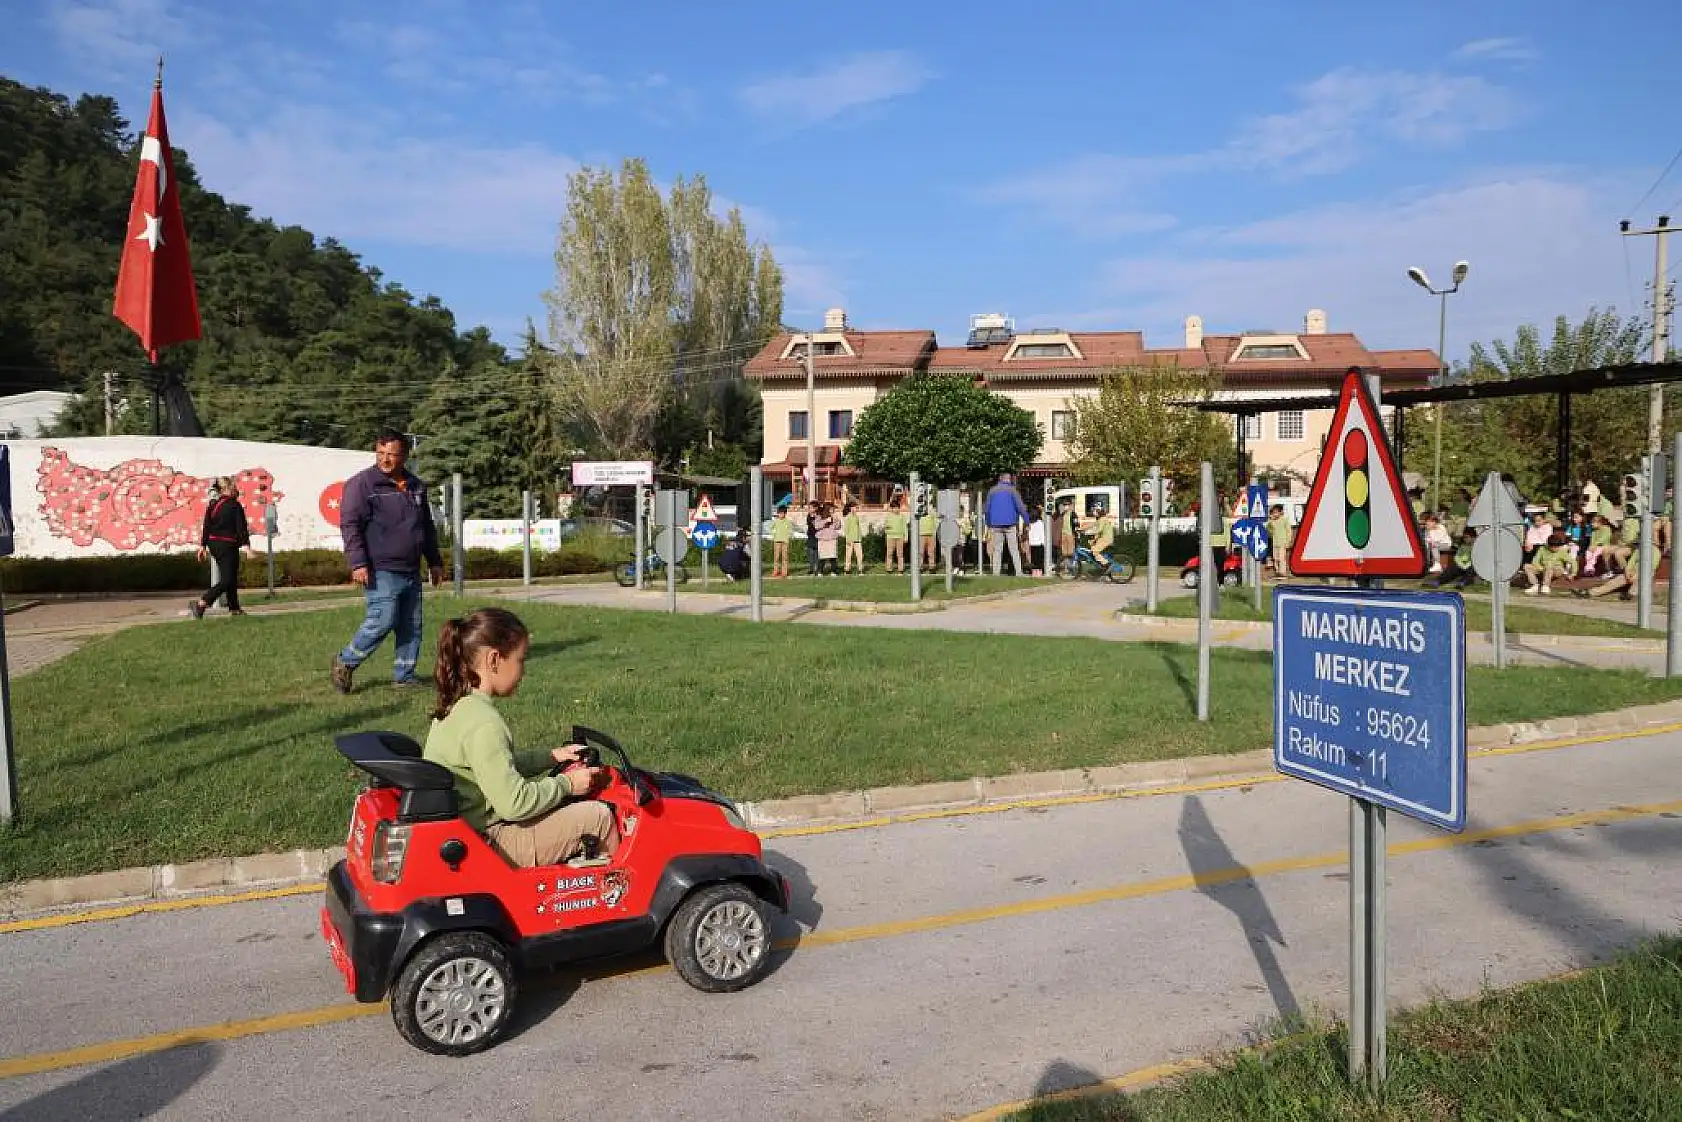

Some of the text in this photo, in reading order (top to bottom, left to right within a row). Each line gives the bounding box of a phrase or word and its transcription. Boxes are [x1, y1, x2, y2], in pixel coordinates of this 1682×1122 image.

[1301, 610, 1426, 653] MARMARİS
[1314, 652, 1411, 696] MERKEZ
[1288, 689, 1341, 726] Nüfus
[1366, 707, 1431, 750] 95624
[1288, 727, 1346, 766] Rakım
[1368, 748, 1388, 779] 11
[556, 876, 594, 889] BLACK
